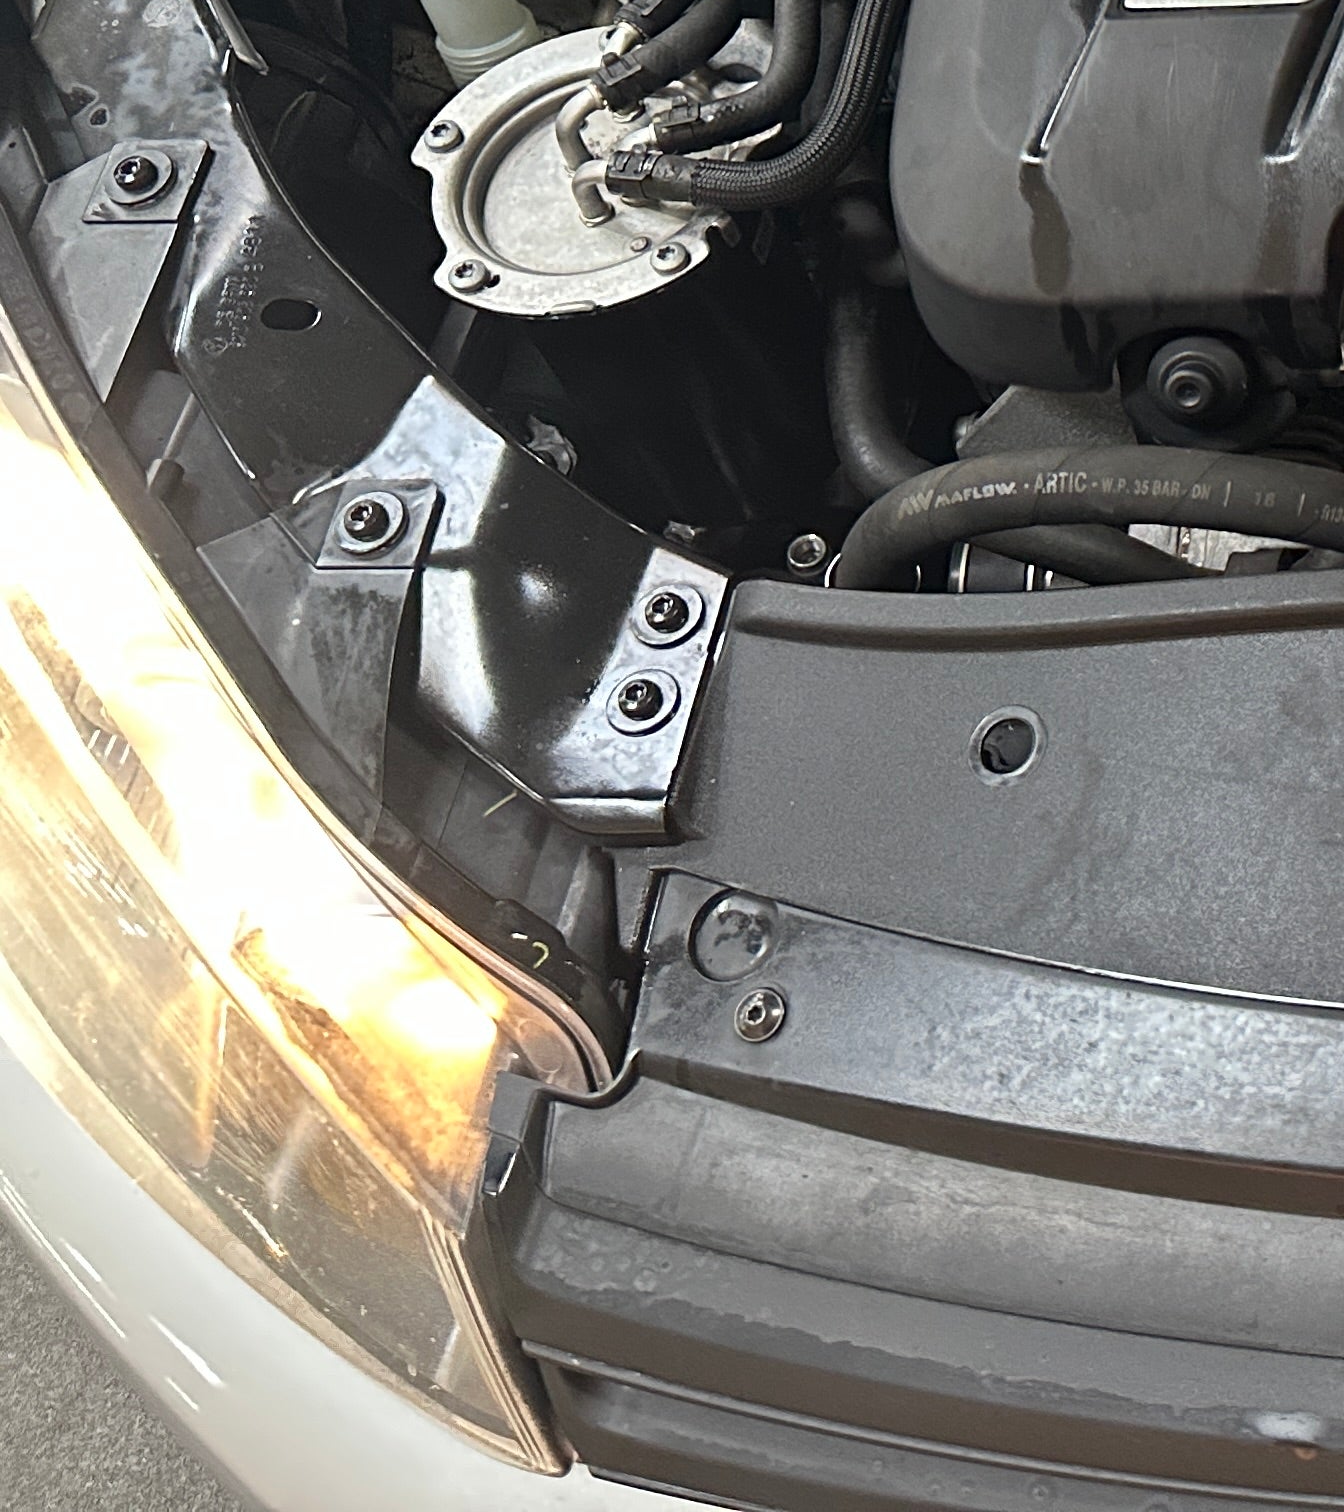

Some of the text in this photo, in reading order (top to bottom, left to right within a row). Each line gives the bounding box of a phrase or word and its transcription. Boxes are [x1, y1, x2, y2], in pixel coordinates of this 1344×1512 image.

[1034, 472, 1087, 494] ARTIC
[1133, 480, 1150, 495] 35
[1152, 480, 1180, 497] BAR
